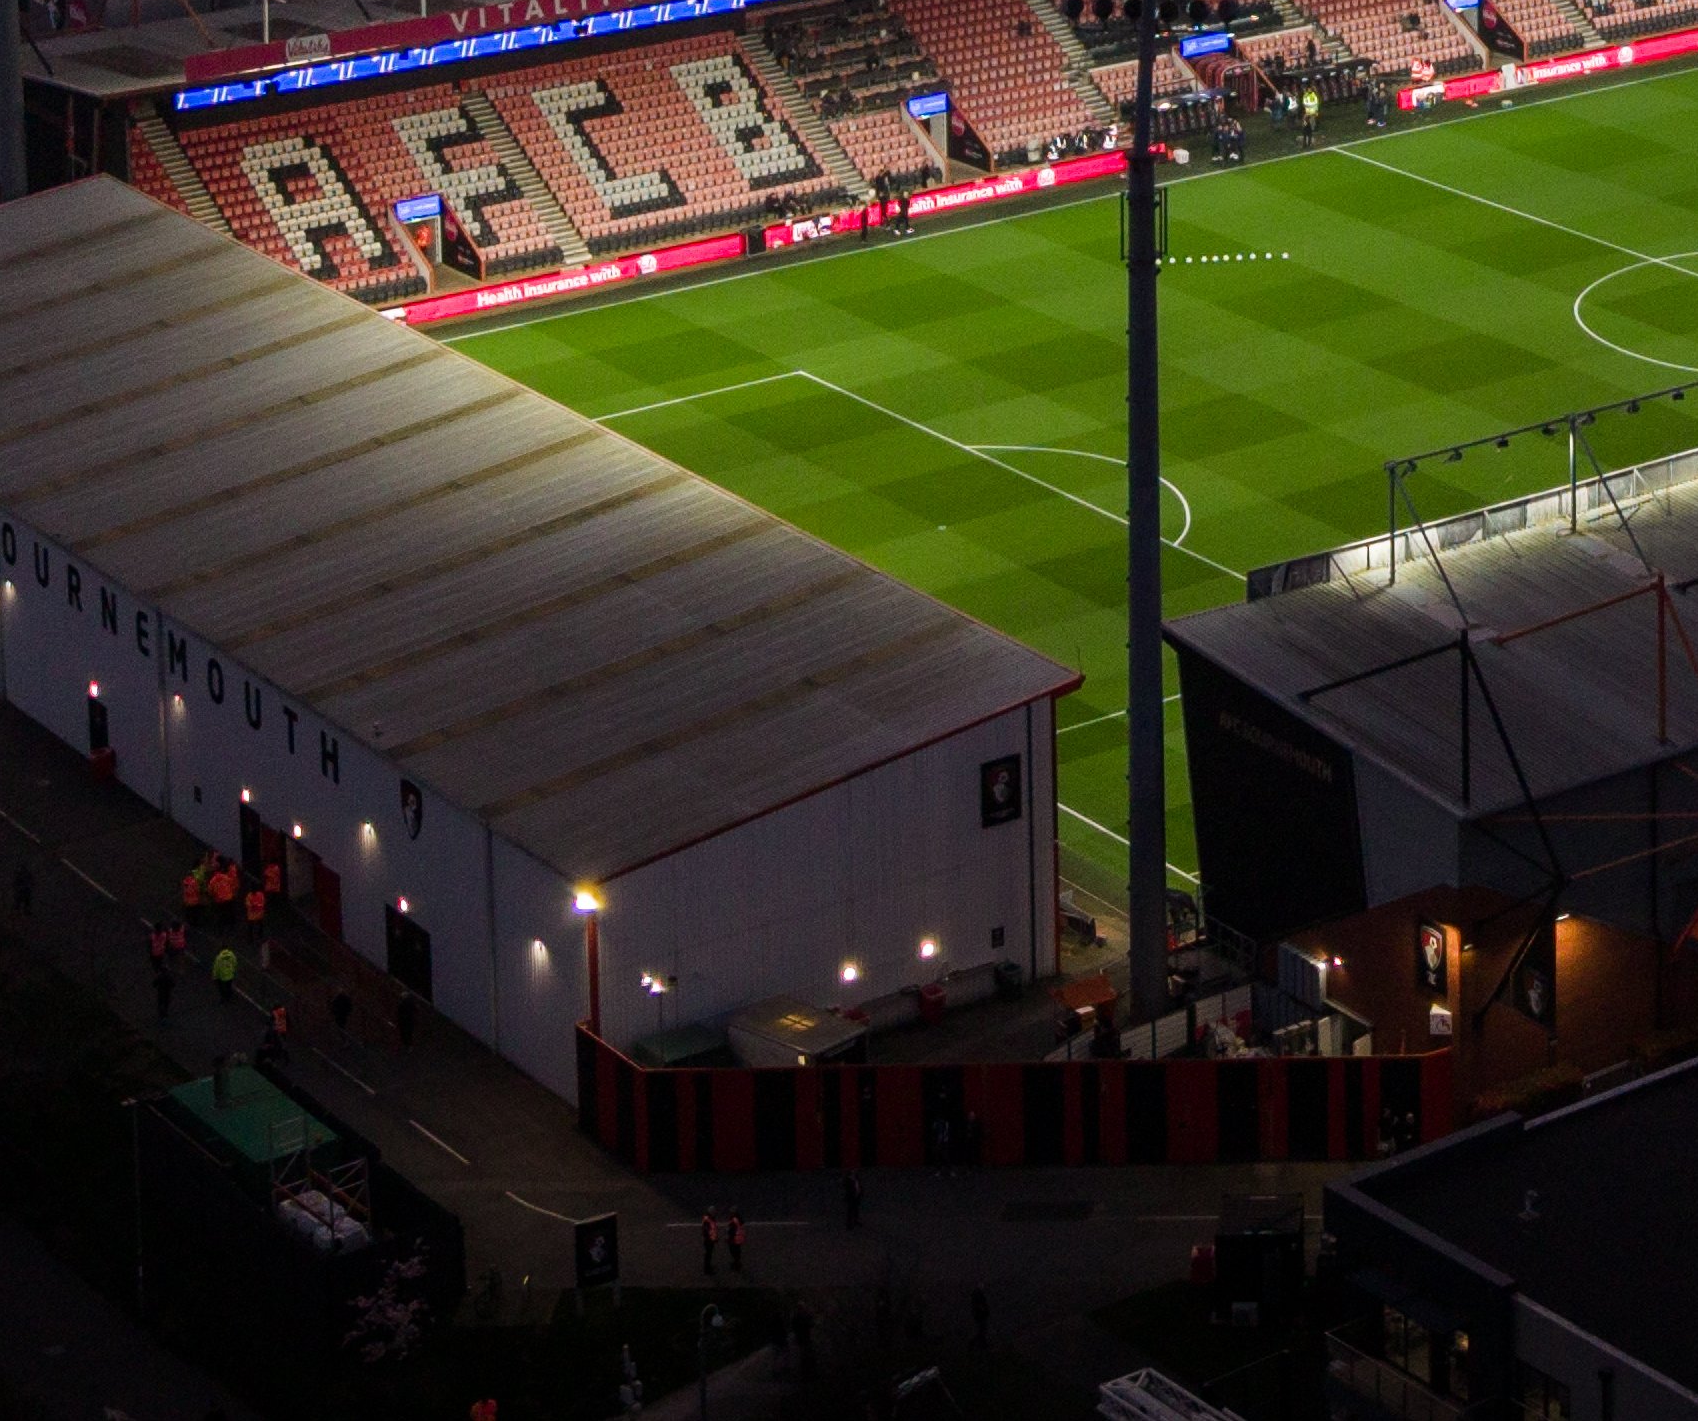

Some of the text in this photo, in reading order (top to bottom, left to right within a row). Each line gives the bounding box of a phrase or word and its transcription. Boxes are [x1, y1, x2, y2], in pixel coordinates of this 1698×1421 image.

[936, 185, 994, 206] insurance
[995, 177, 1024, 195] with
[477, 264, 621, 308] Health insurance with
